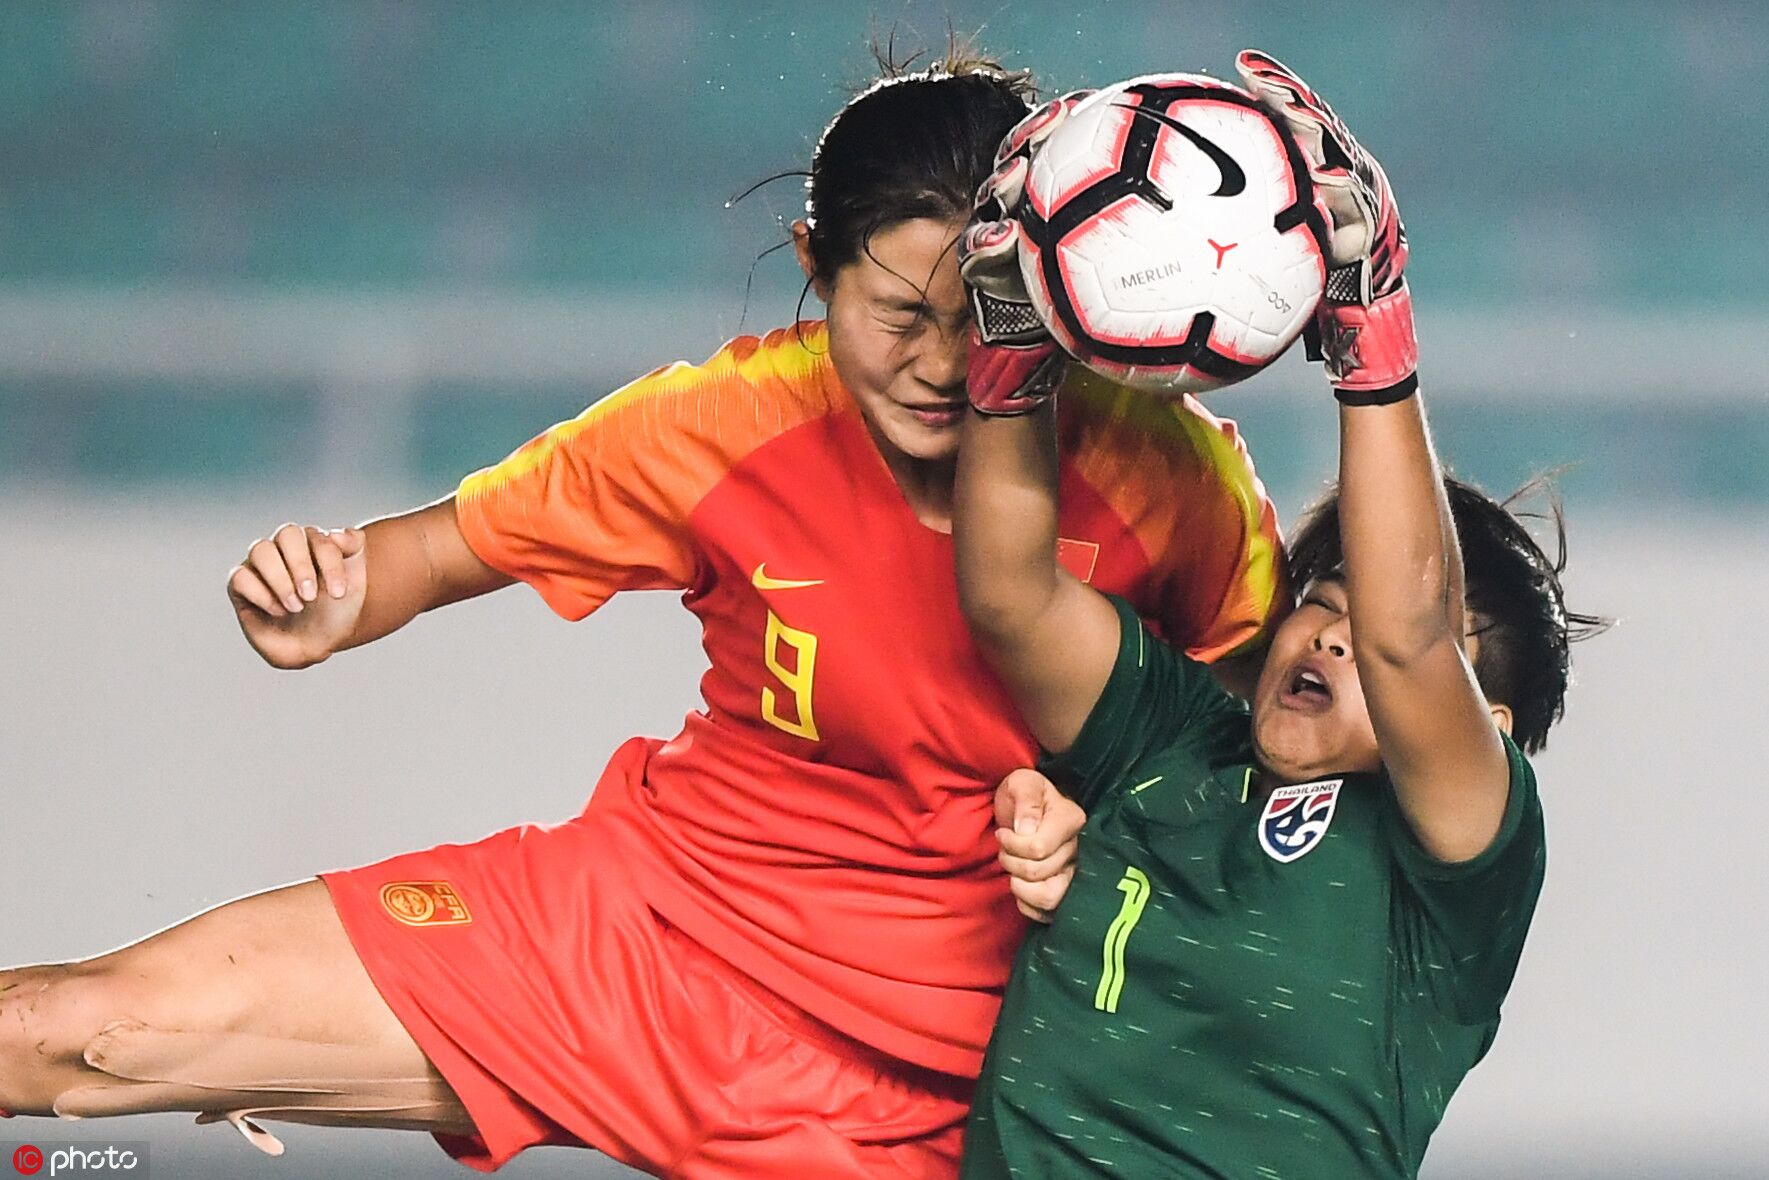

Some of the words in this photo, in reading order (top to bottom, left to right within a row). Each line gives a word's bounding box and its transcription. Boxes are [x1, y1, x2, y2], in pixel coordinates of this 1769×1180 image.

[1120, 260, 1182, 289] MERLIN
[761, 608, 820, 742] 9
[1276, 783, 1338, 797] THAILAND
[434, 884, 466, 920] CFA
[1094, 865, 1151, 1014] 1
